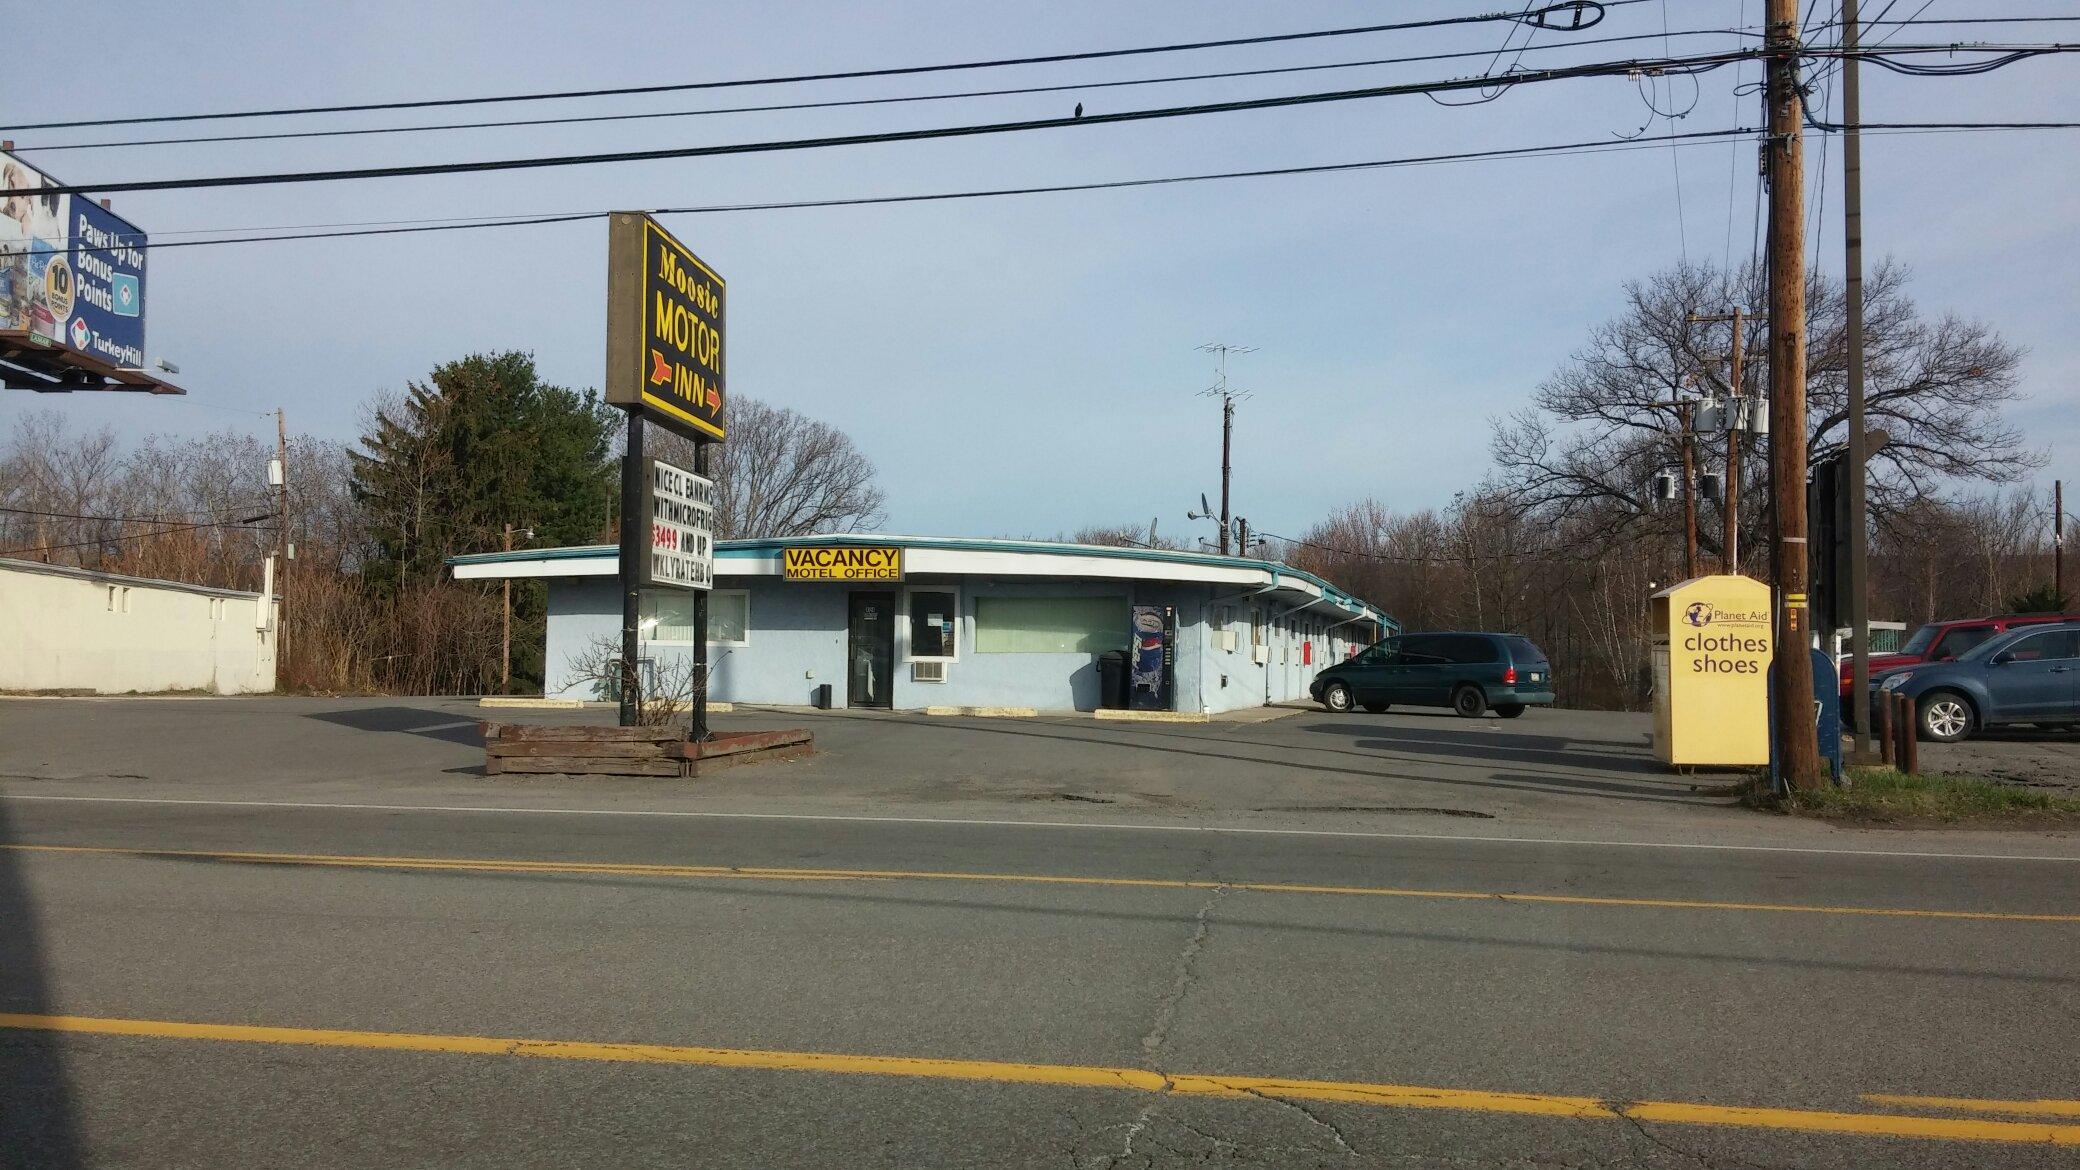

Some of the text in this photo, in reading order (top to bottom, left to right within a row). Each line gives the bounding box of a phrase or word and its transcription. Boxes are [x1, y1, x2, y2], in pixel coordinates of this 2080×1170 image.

[79, 213, 144, 271] Paws Up for
[77, 243, 113, 283] Bonus
[52, 264, 68, 295] 10
[659, 243, 719, 319] Moosic
[51, 291, 69, 306] BONUS
[76, 273, 112, 312] Points
[51, 300, 69, 313] POINTS
[656, 289, 720, 375] MOTOR
[674, 362, 705, 408] INN
[655, 466, 673, 494] NICE
[697, 535, 707, 557] UP
[787, 549, 897, 567] VACANCY
[787, 568, 897, 578] MOTEL OFFICE
[1714, 610, 1768, 621] Planet Aid
[1684, 633, 1767, 653] clothes
[1693, 654, 1758, 674] shoes
